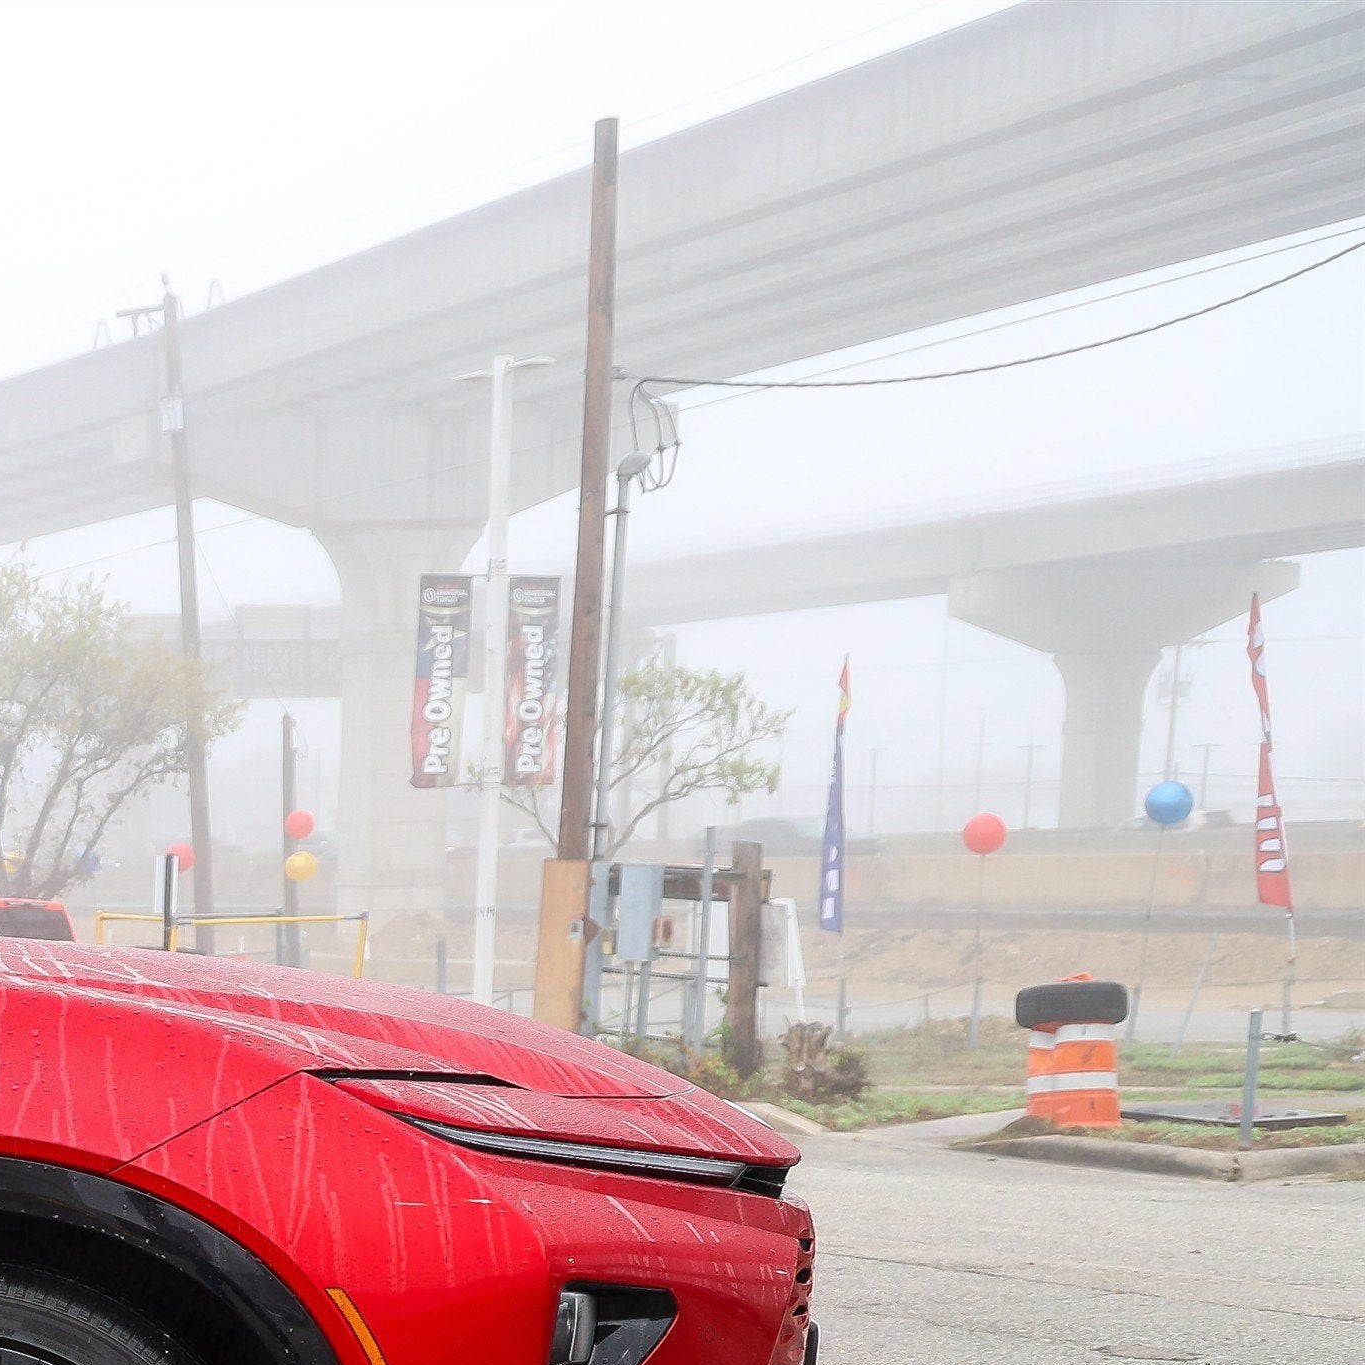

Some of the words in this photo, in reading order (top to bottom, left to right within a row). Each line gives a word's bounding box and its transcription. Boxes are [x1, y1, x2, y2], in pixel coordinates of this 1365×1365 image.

[423, 624, 453, 721] Owned
[519, 625, 545, 721] Owned
[423, 726, 451, 774] Pre
[517, 726, 544, 773] Pre
